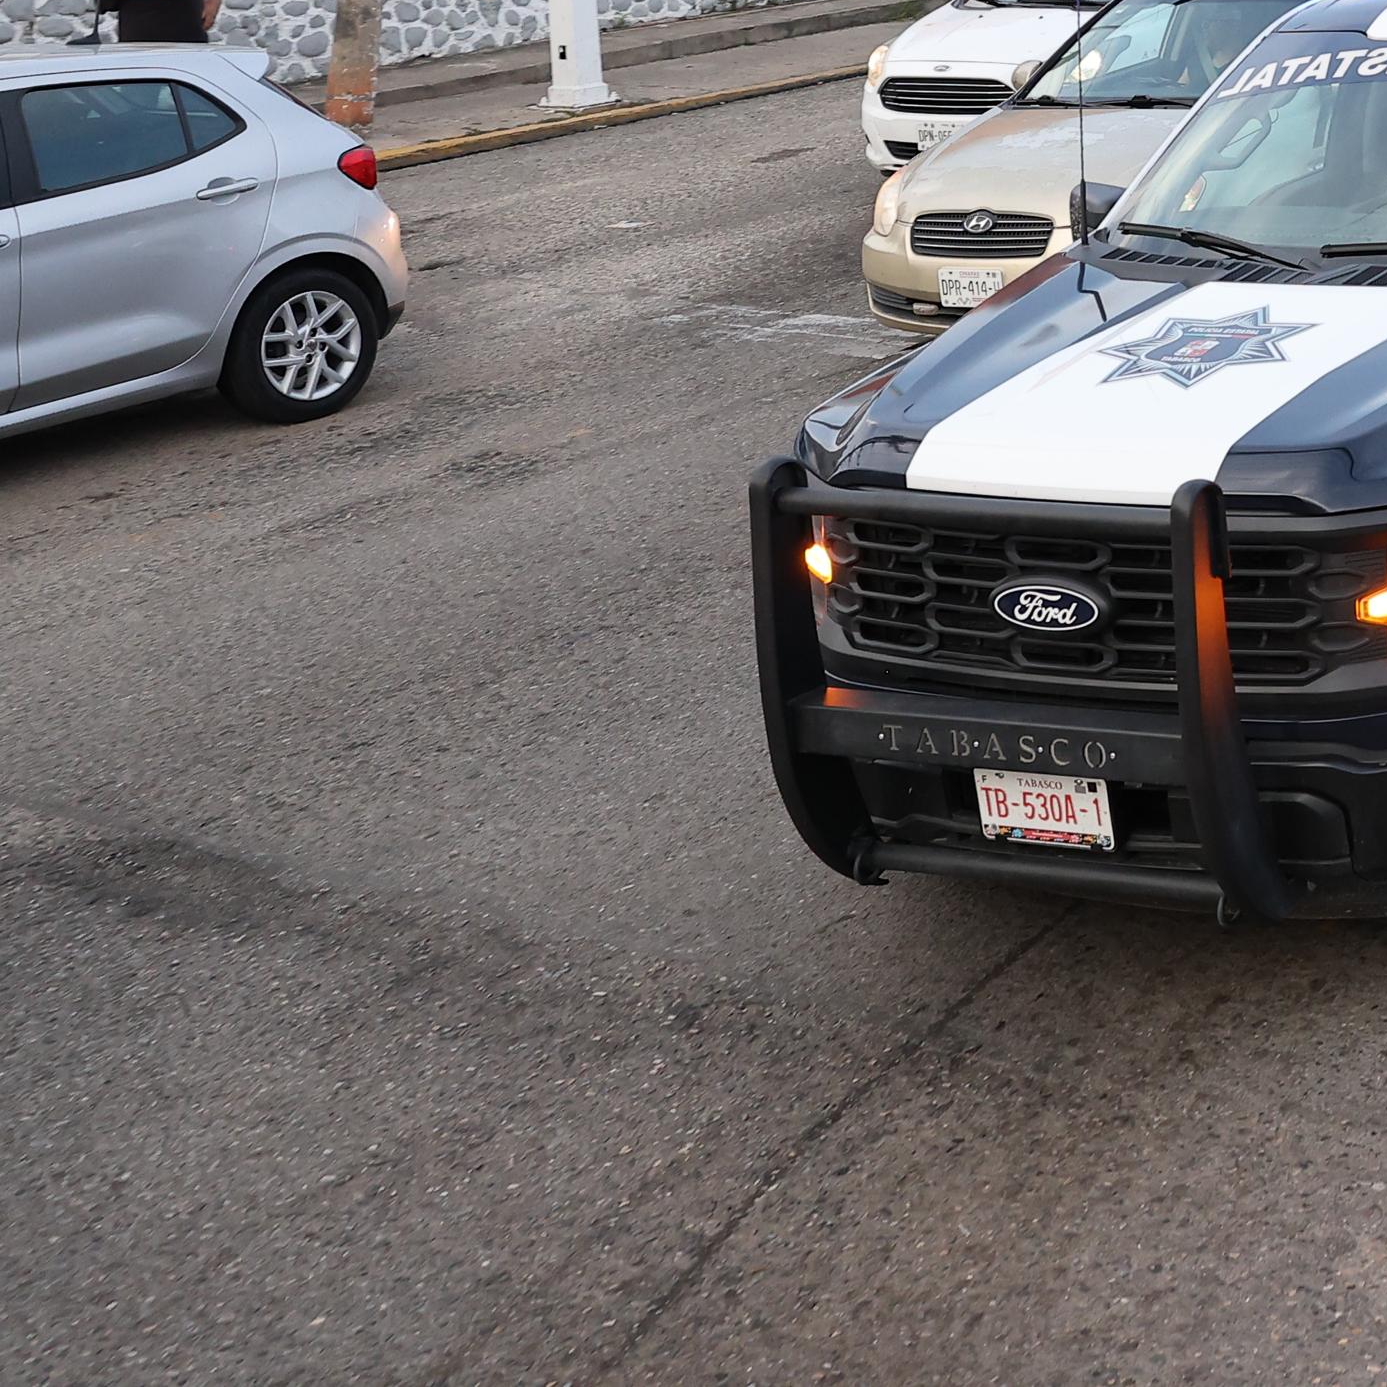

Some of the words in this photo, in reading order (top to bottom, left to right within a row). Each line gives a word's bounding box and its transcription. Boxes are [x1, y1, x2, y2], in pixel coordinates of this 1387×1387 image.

[1014, 591, 1078, 625] Ford
[883, 725, 1107, 769] TABASCO
[981, 775, 987, 783] F
[1017, 777, 1063, 790] TABASCO
[981, 787, 1103, 827] TB-530A-1
